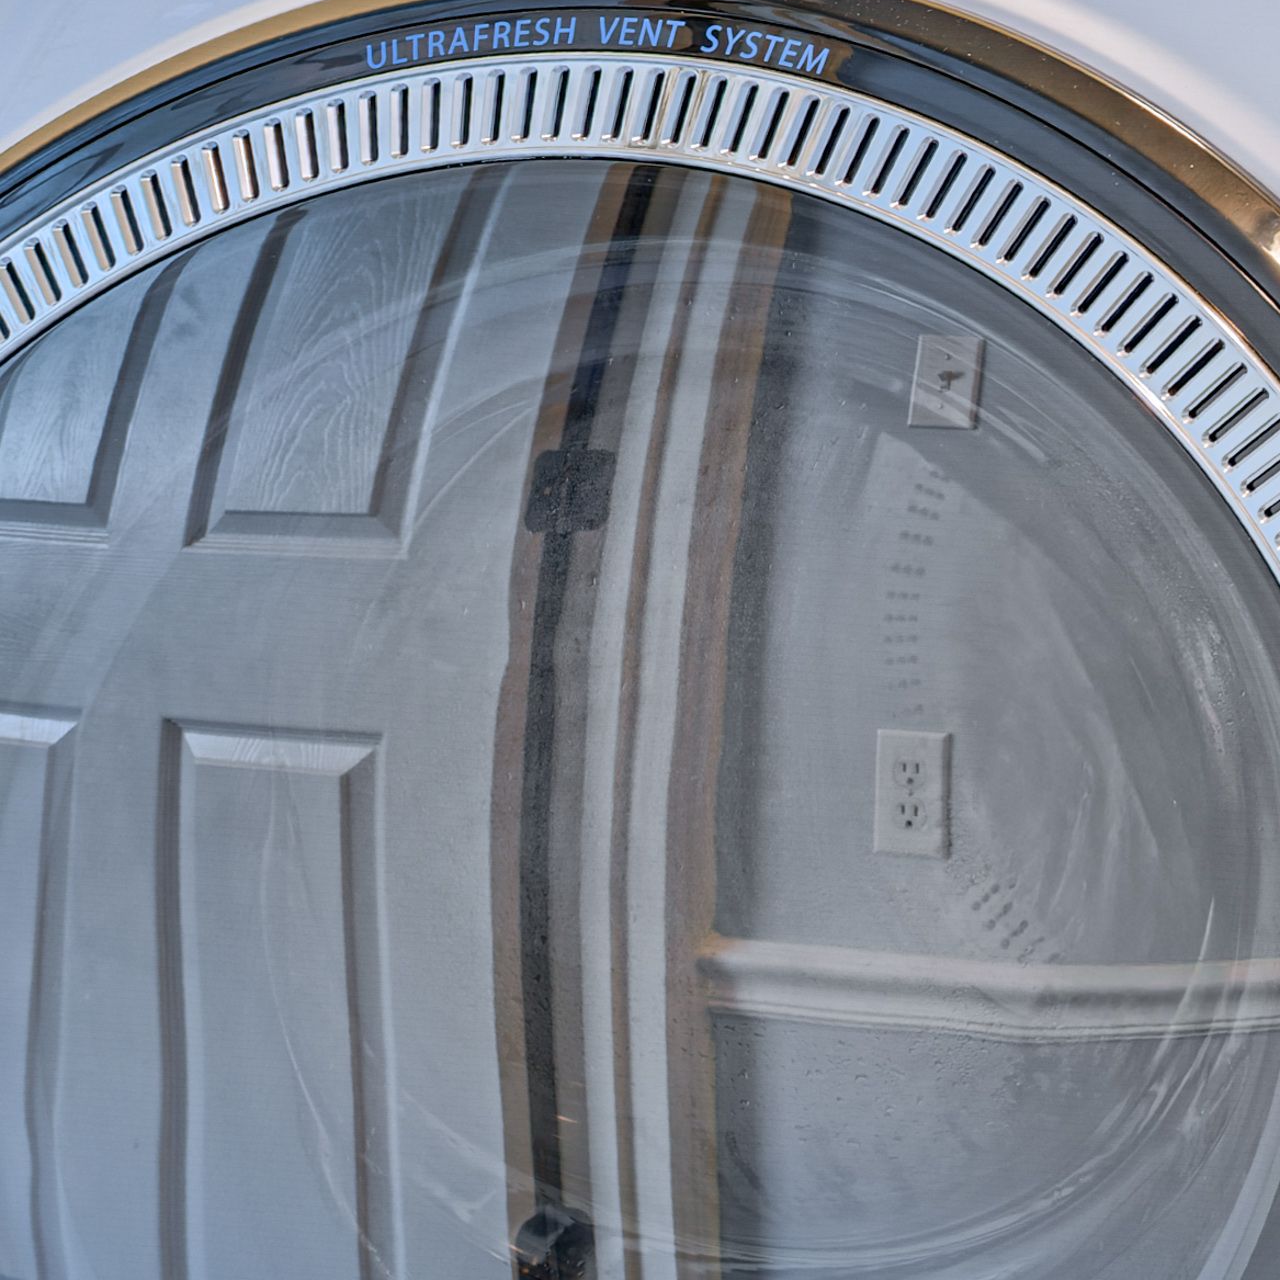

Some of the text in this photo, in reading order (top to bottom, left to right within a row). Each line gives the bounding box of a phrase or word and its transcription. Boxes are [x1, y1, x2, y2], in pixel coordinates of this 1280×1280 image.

[365, 16, 830, 75] ULTRAFRESH VENT SYSTEM
